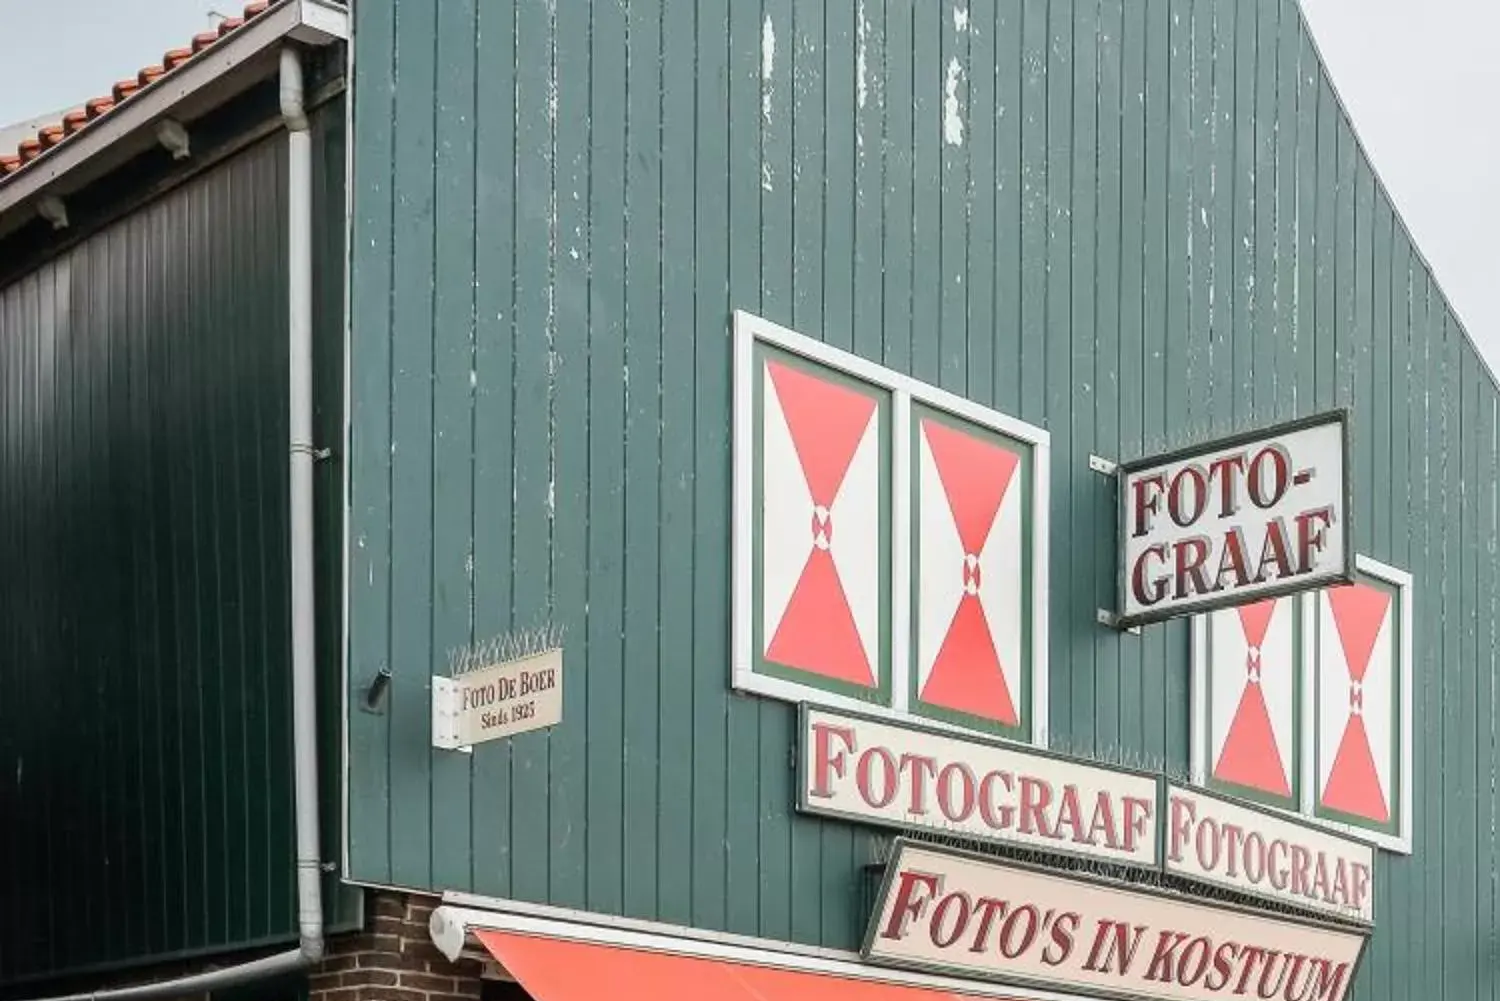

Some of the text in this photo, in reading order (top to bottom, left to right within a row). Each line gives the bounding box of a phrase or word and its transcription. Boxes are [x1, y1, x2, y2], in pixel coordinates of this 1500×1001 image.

[1131, 446, 1312, 537] FOTO-
[1131, 508, 1333, 606] GRAAF
[462, 684, 495, 710] FOTO
[520, 668, 556, 696] BOER
[481, 706, 509, 729] Sinds
[809, 722, 1155, 855] FOTOGRAAF
[1168, 794, 1371, 912] FOTOGRAAF
[880, 870, 1082, 964] FOTO'S
[1083, 917, 1142, 976] IN
